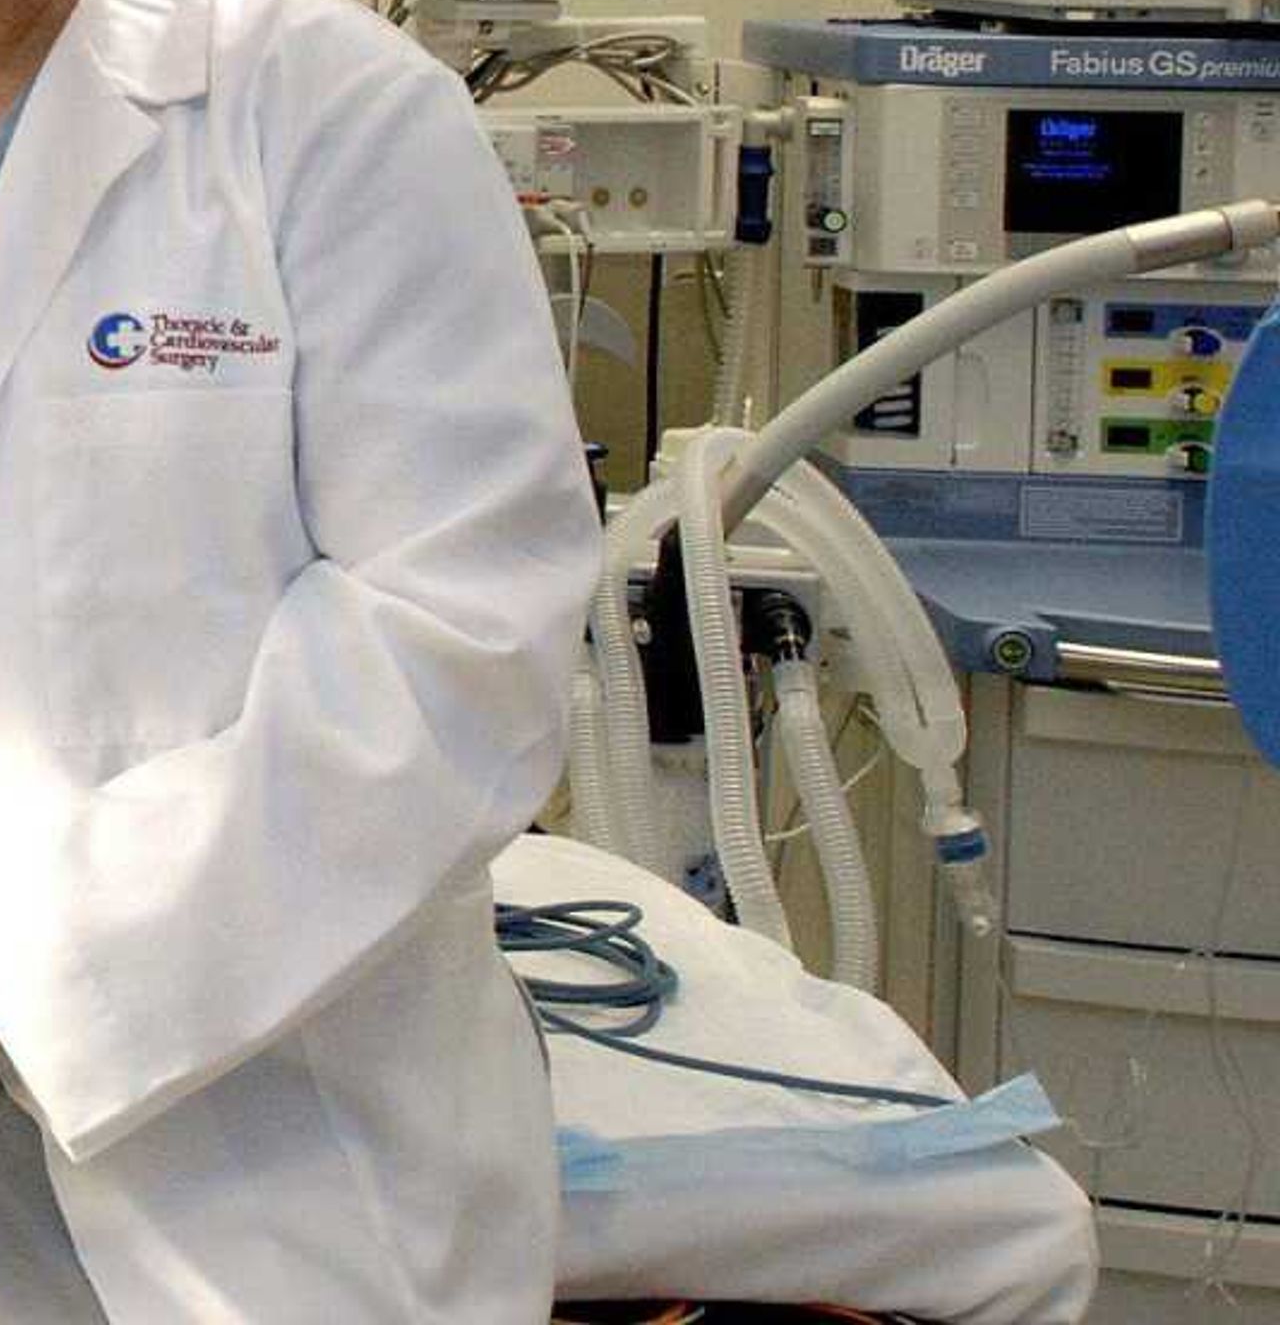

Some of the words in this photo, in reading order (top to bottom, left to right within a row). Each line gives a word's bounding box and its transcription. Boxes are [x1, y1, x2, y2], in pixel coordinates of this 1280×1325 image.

[900, 45, 987, 77] Dräger
[1050, 49, 1142, 76] Fabius
[1149, 50, 1198, 77] GS
